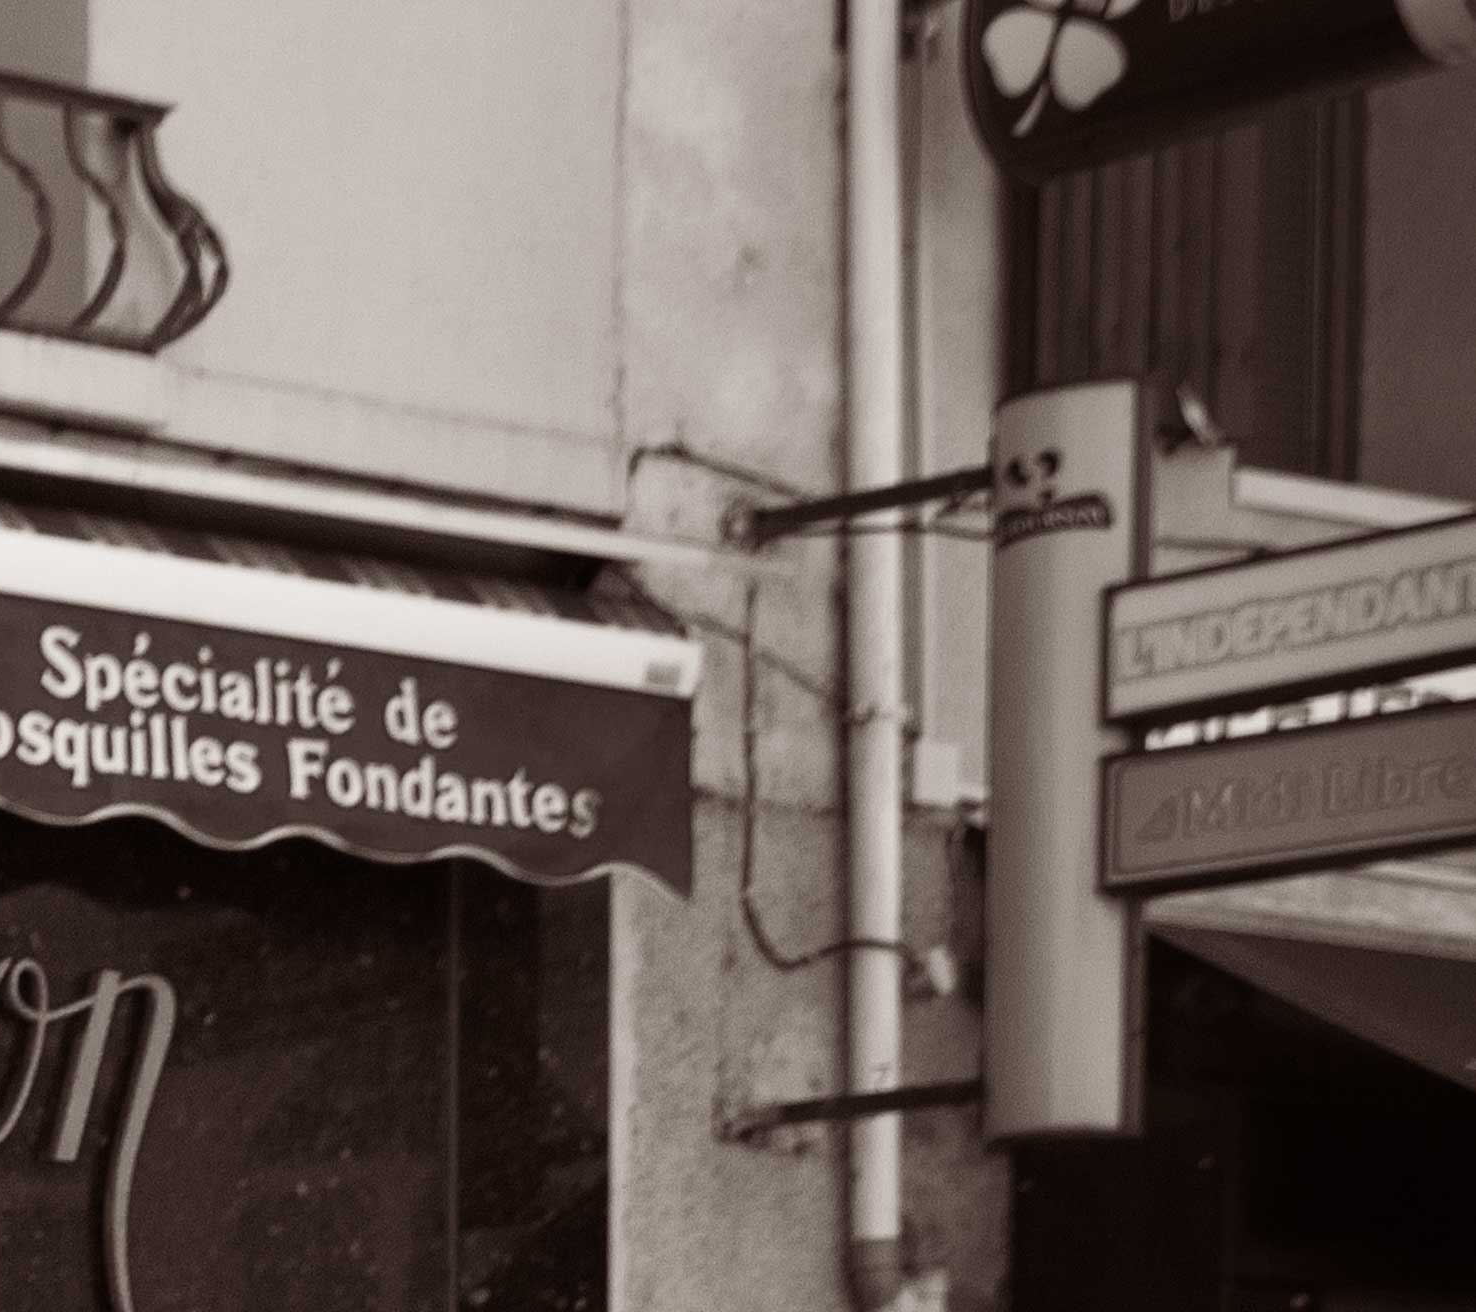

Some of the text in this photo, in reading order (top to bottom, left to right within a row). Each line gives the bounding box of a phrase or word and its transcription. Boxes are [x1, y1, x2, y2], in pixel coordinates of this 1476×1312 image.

[39, 624, 459, 750] Spécialité de
[285, 738, 604, 838] Fondantes
